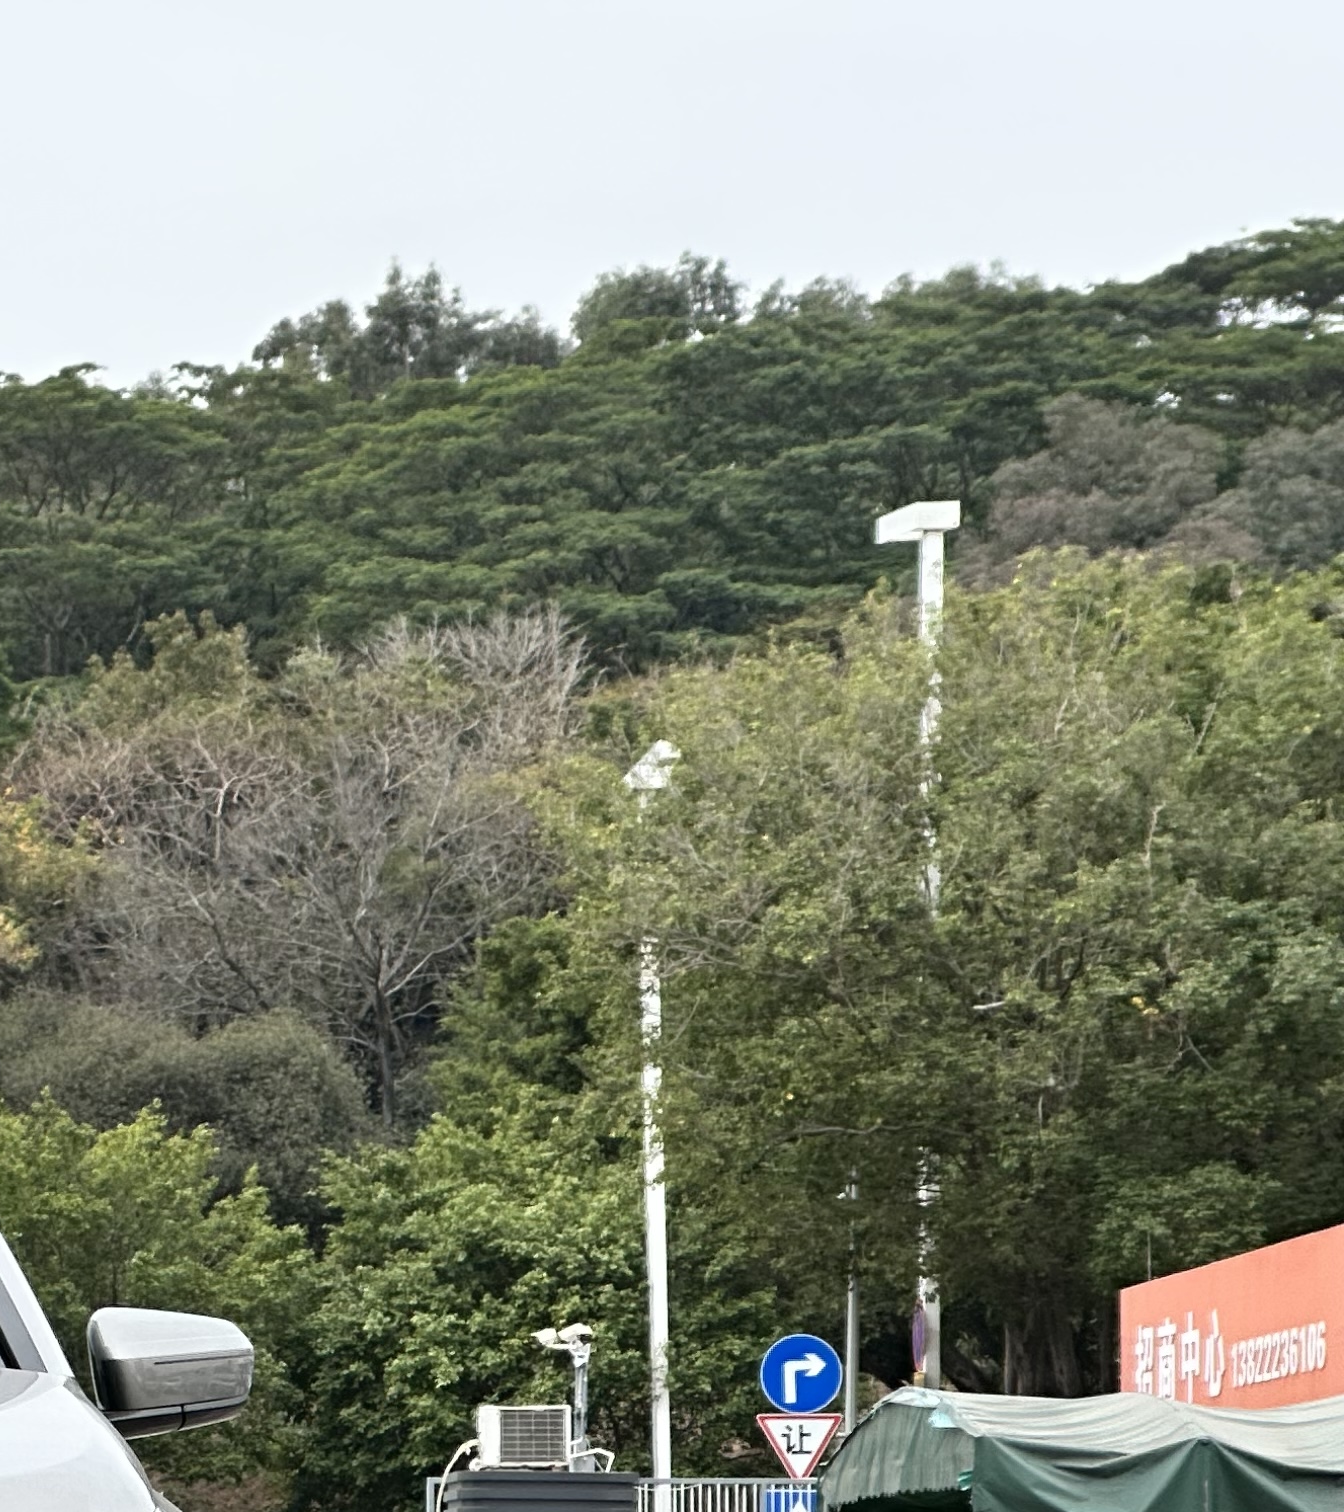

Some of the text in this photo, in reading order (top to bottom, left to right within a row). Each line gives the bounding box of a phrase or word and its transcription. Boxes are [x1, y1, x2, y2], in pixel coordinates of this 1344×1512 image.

[1134, 1308, 1226, 1404] 招商中心
[780, 1424, 812, 1455] 让
